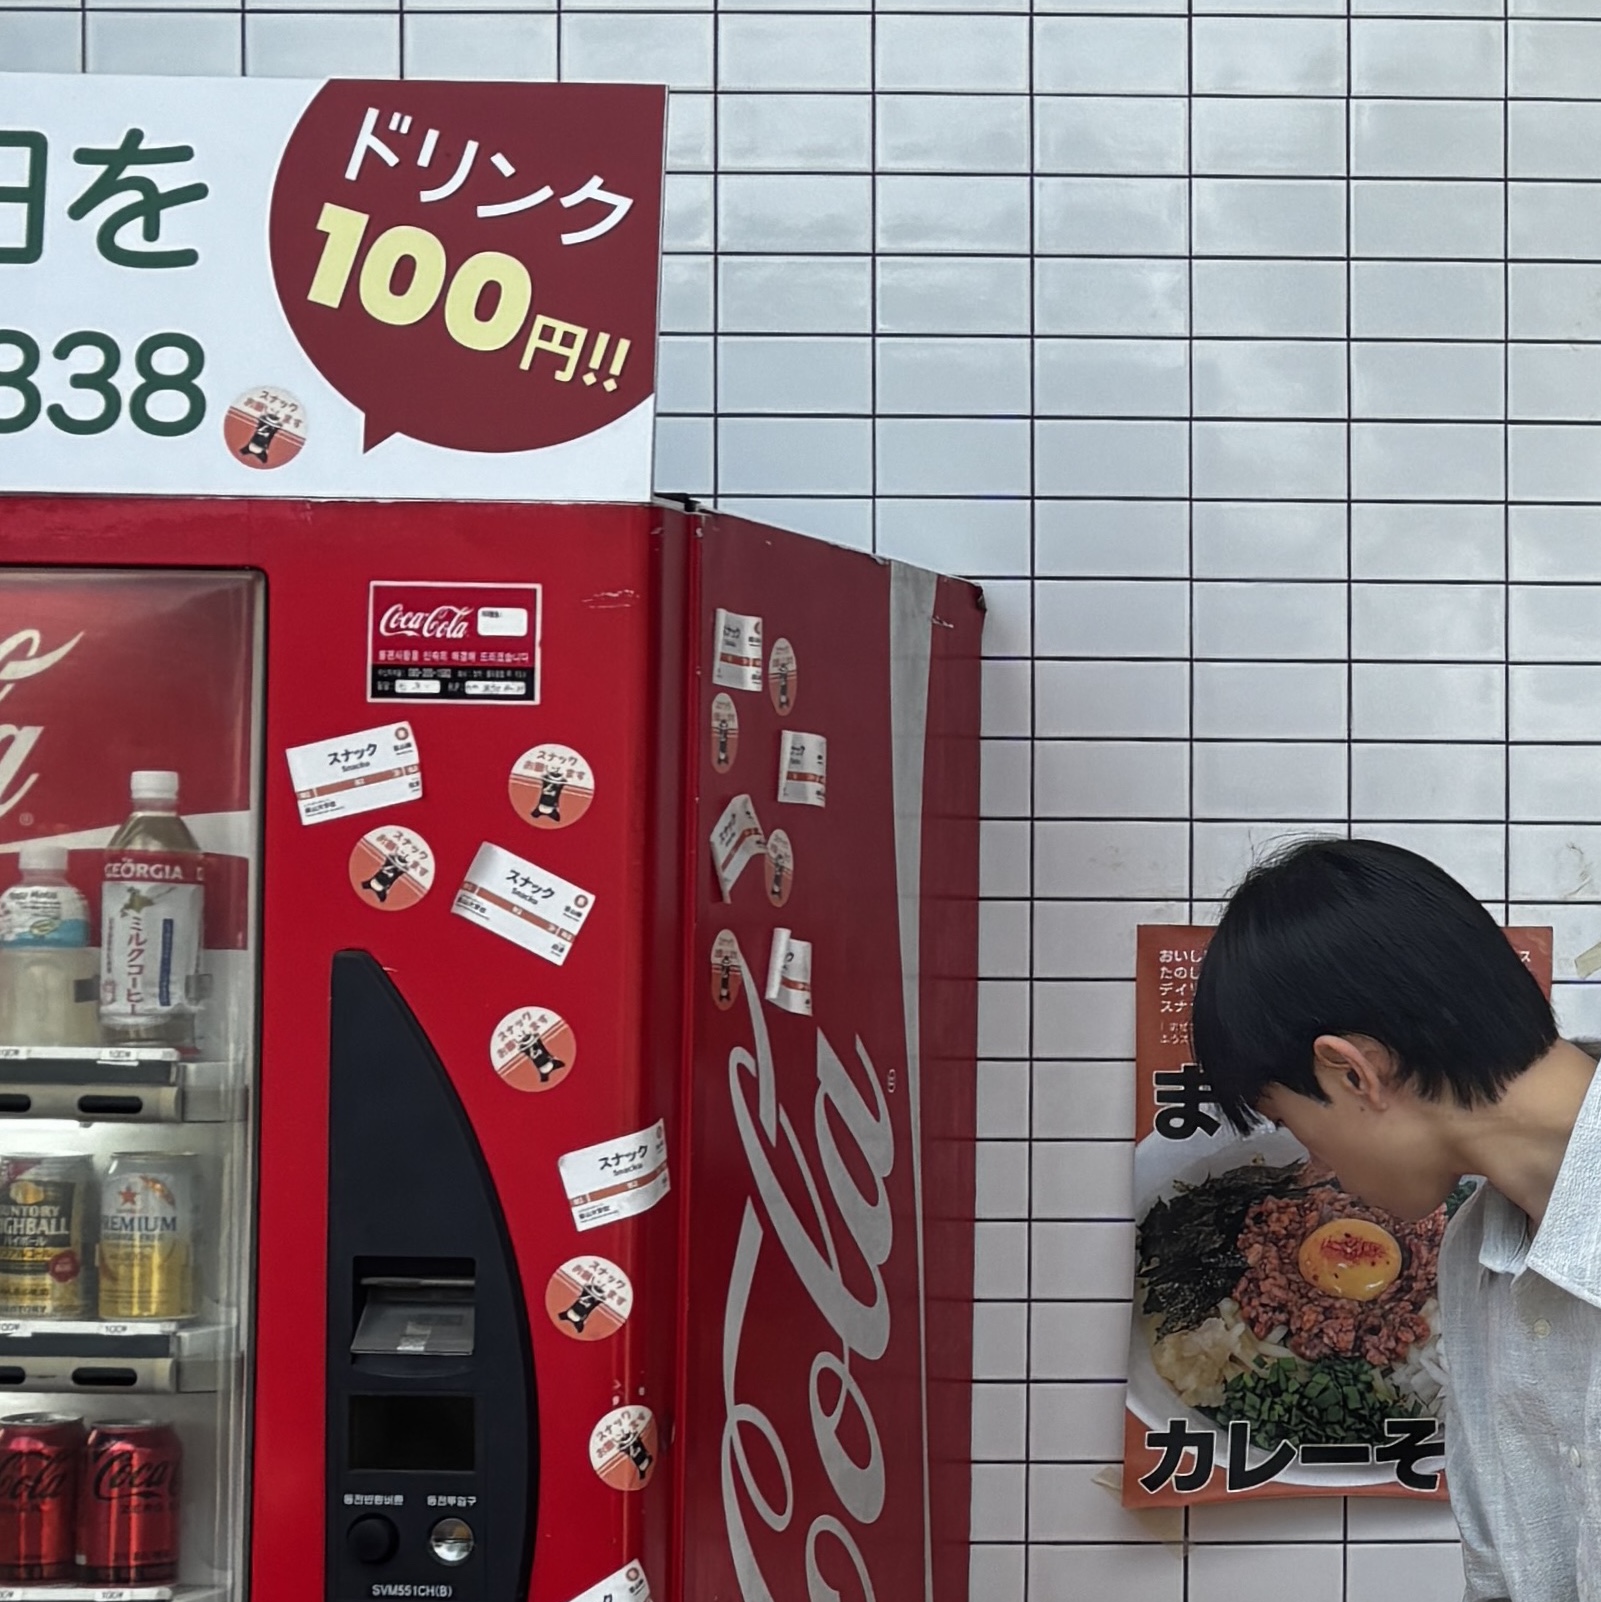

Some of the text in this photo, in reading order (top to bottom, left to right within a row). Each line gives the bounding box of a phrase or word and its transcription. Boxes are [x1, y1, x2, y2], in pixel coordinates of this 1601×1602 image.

[344, 106, 634, 246] ドリンク
[379, 603, 475, 639] Coca-Cola
[327, 742, 377, 766] スナック
[505, 868, 554, 899] スナック
[126, 915, 148, 1016] ミルクコーヒー
[1159, 949, 1207, 963] おいし
[598, 1144, 649, 1171] スナック
[371, 1584, 453, 1598] SVM551CH(B)
